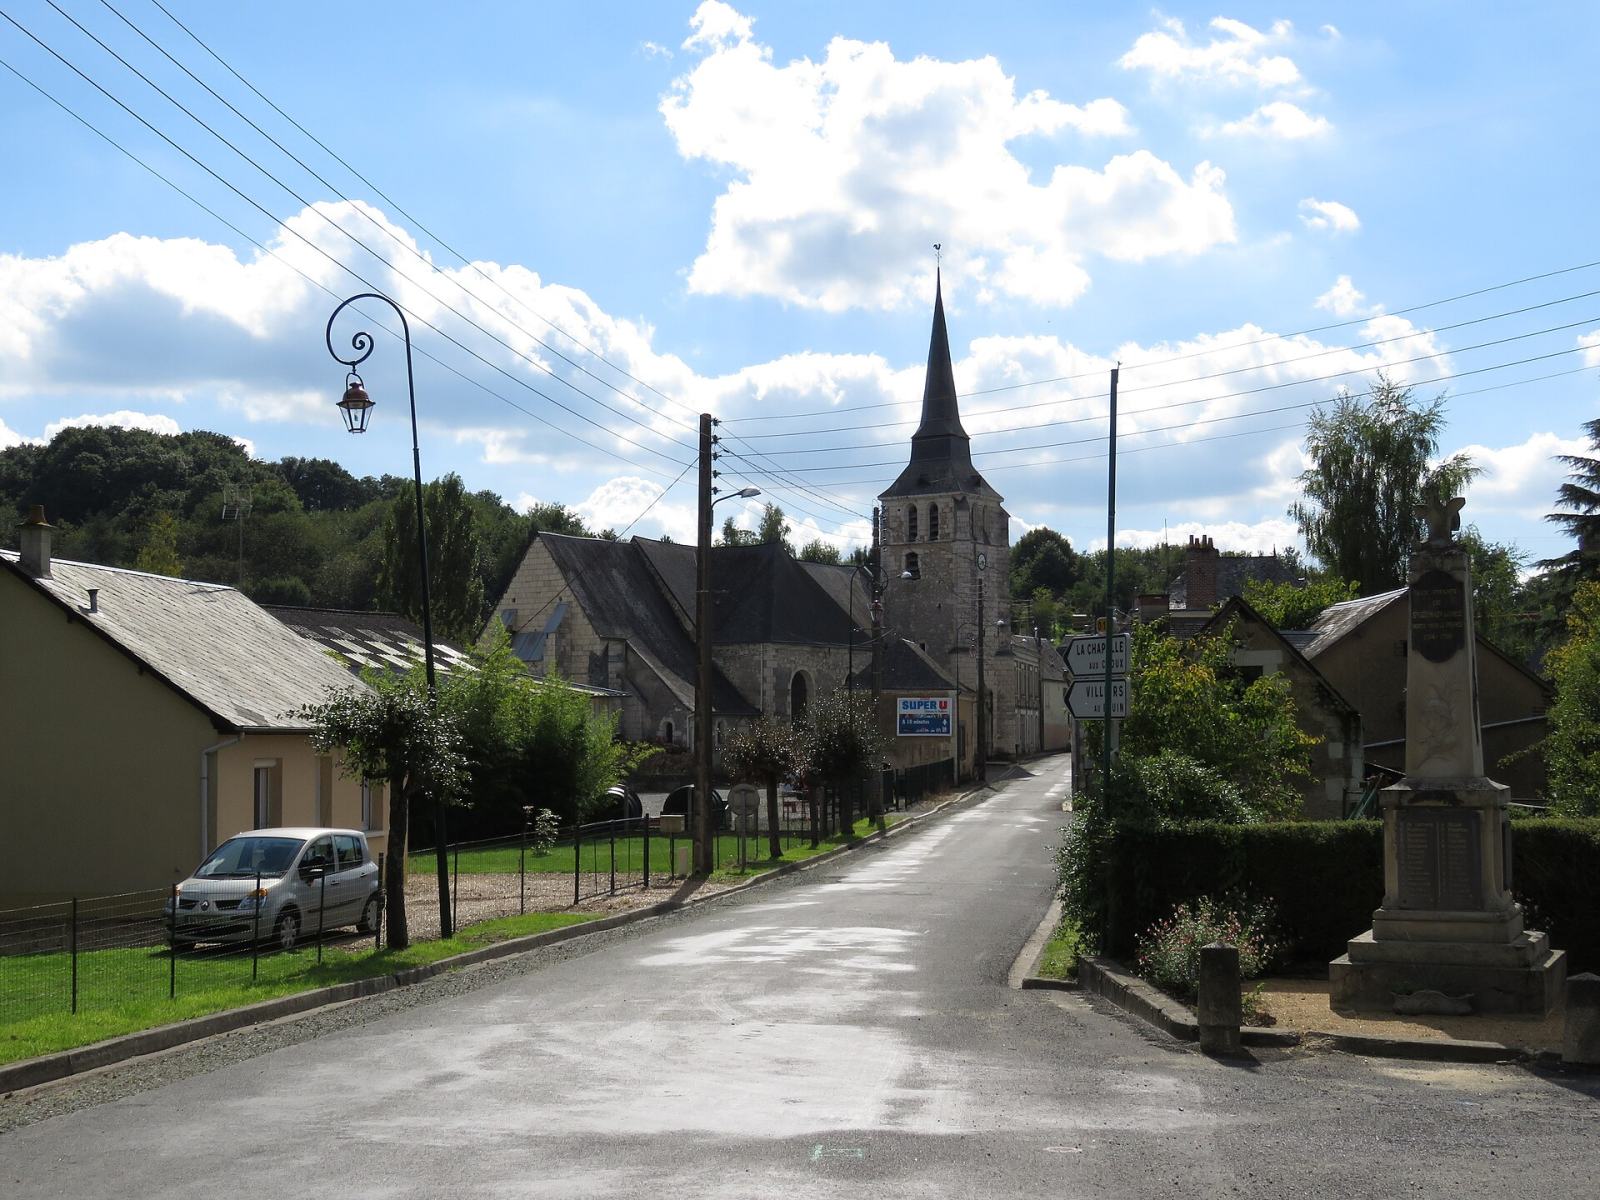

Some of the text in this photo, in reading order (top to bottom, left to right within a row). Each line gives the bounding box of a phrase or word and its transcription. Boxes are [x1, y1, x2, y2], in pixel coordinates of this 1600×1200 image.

[1076, 644, 1085, 656] LA
[1102, 659, 1124, 669] COUX
[1086, 685, 1123, 698] VILLRS
[902, 700, 948, 710] SUPER U
